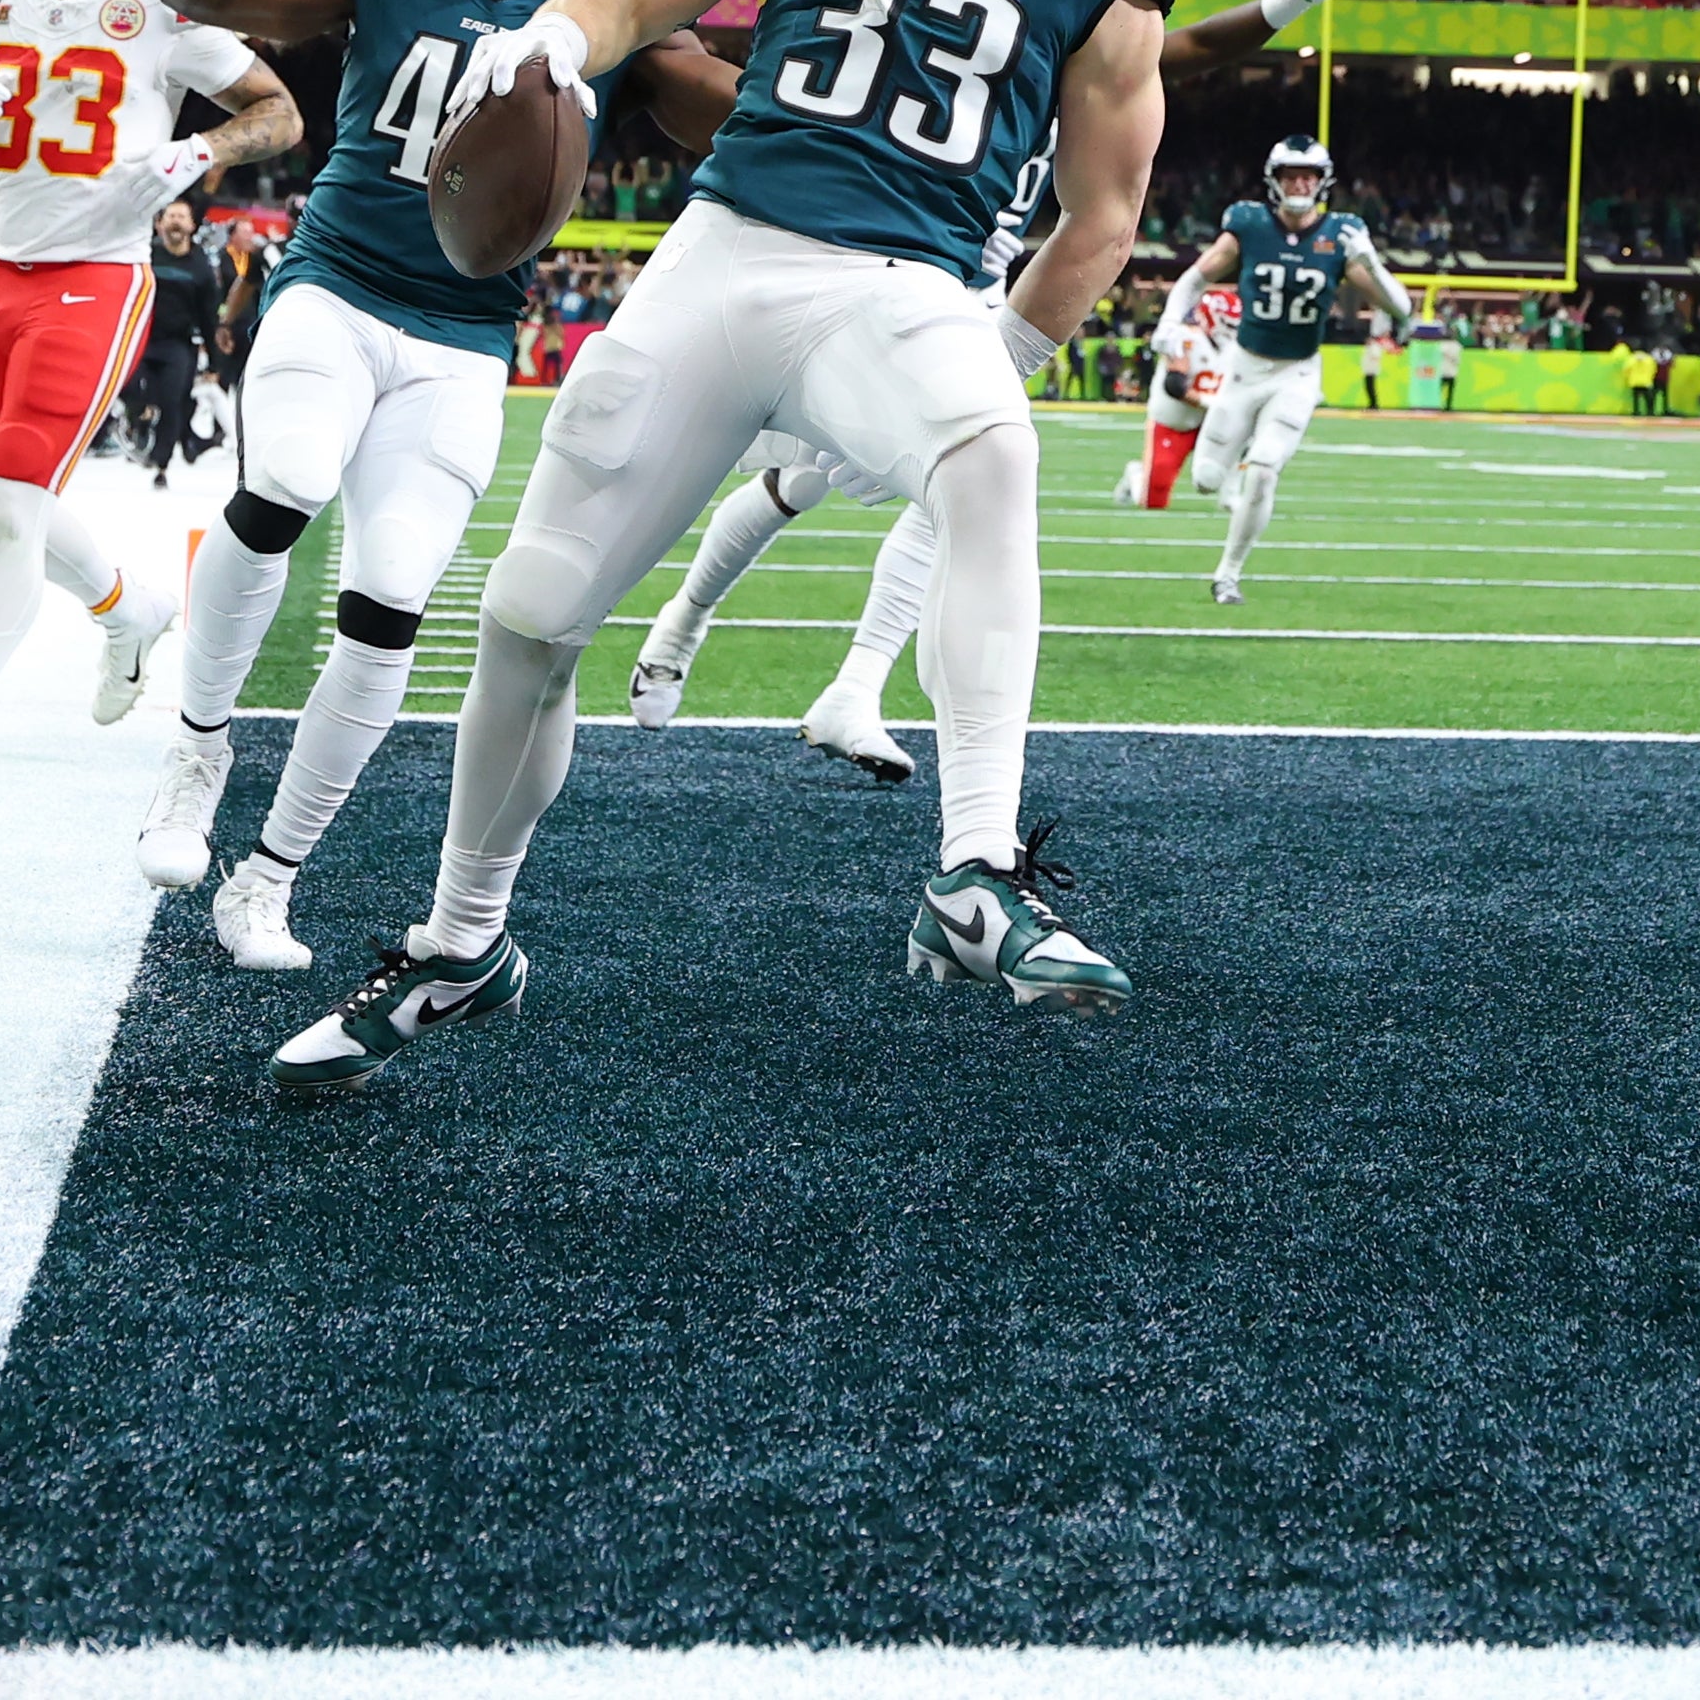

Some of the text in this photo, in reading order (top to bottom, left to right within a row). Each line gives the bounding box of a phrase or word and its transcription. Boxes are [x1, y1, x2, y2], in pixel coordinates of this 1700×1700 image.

[460, 16, 507, 35] EAGL
[373, 34, 457, 184] 4
[1252, 262, 1327, 325] 32
